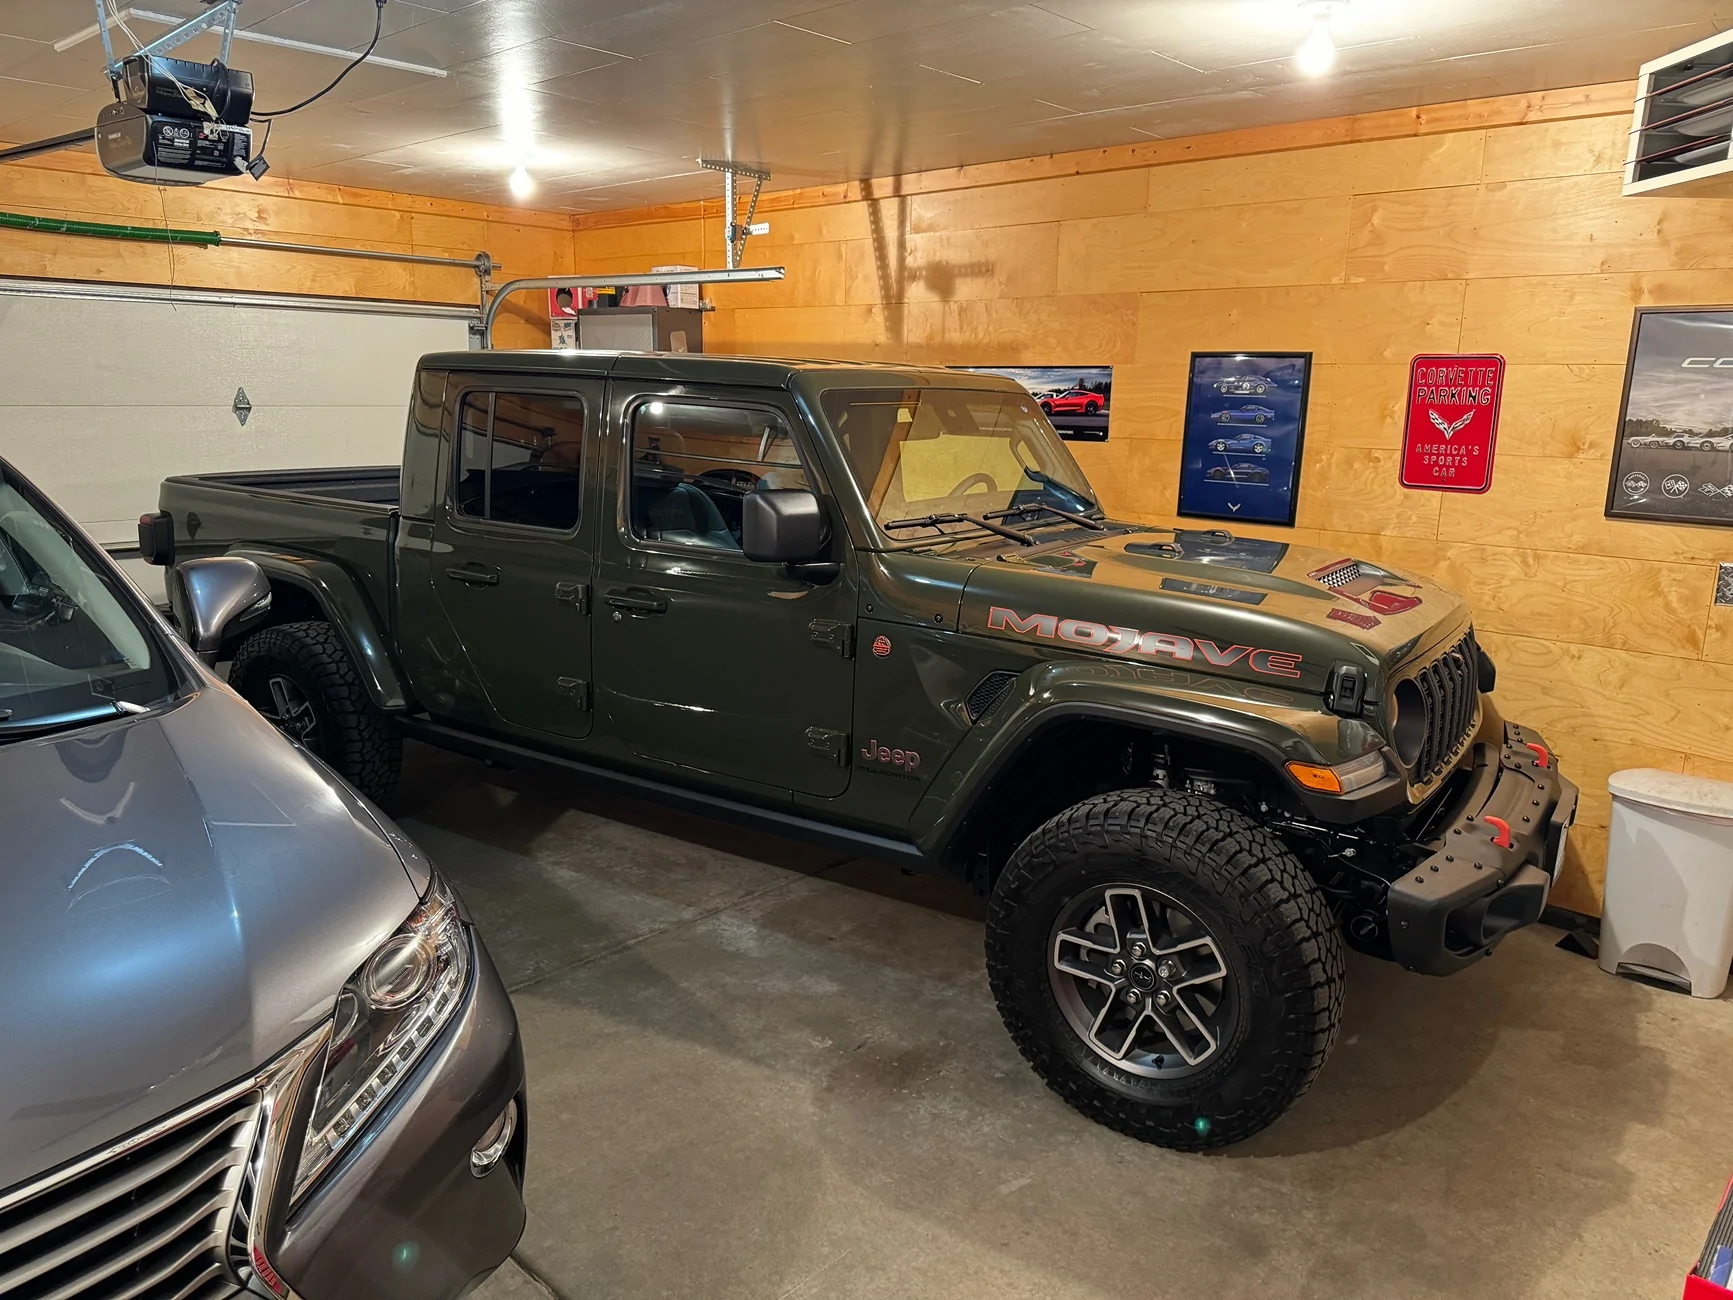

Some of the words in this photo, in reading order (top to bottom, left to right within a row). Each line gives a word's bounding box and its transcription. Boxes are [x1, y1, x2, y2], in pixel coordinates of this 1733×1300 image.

[1417, 366, 1496, 386] CORVETTE
[1416, 386, 1492, 406] PARKING
[1416, 443, 1480, 456] AMERICA'S
[1423, 455, 1468, 467] SPORTS
[1432, 467, 1456, 478] CAR
[987, 606, 1303, 679] MOJAVE
[861, 739, 921, 772] Jeep
